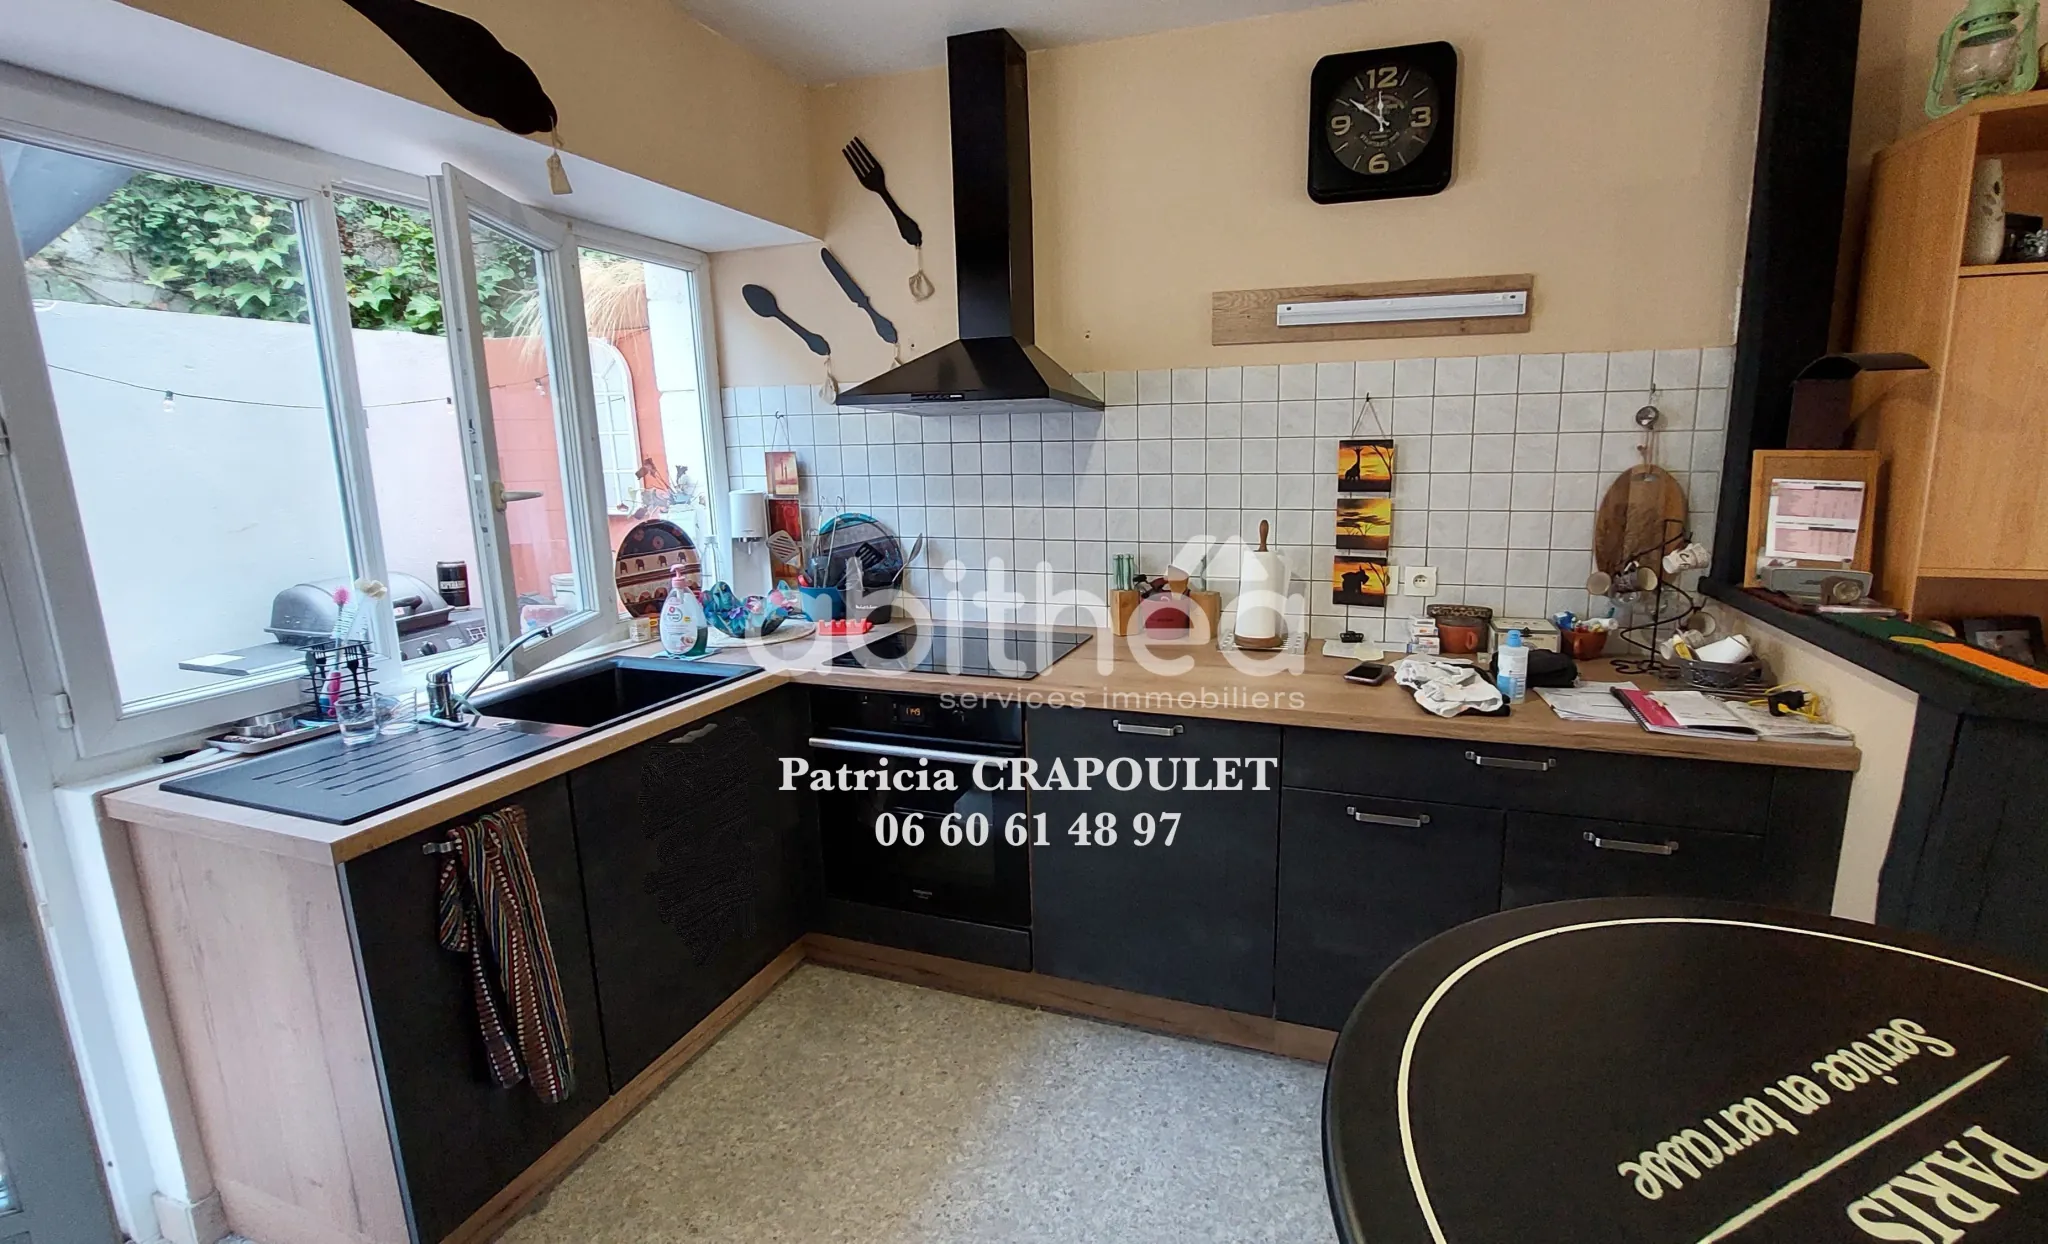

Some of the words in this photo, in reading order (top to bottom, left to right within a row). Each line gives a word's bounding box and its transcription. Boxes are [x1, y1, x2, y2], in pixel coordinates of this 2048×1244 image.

[1366, 66, 1398, 90] 12
[1331, 115, 1351, 136] 9
[1410, 106, 1431, 128] 3
[1368, 153, 1389, 174] 6
[1811, 1018, 1956, 1092] Service
[1764, 1075, 1831, 1115] en
[1617, 1097, 1799, 1200] terrasse
[1846, 1125, 2048, 1244] PARIS
